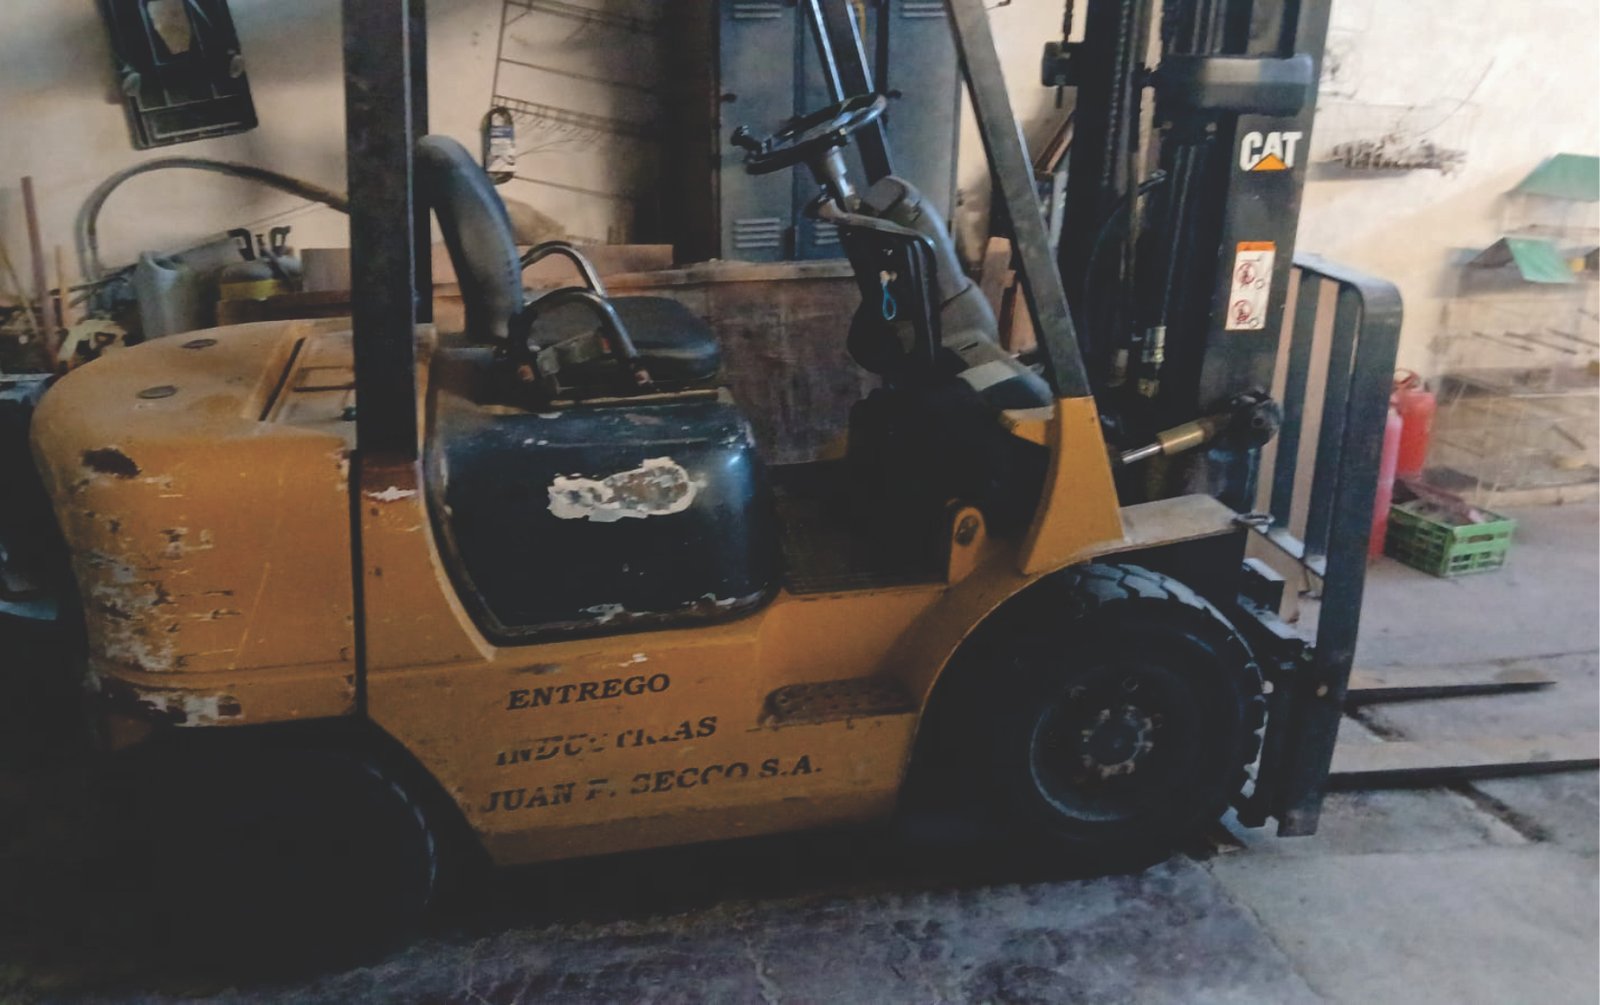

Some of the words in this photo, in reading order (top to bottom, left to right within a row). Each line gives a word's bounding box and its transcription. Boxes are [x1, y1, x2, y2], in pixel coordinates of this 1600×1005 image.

[1239, 131, 1303, 172] CAT
[506, 673, 670, 711] ENTREGO
[480, 782, 576, 813] JUAN
[758, 755, 823, 778] S.A.
